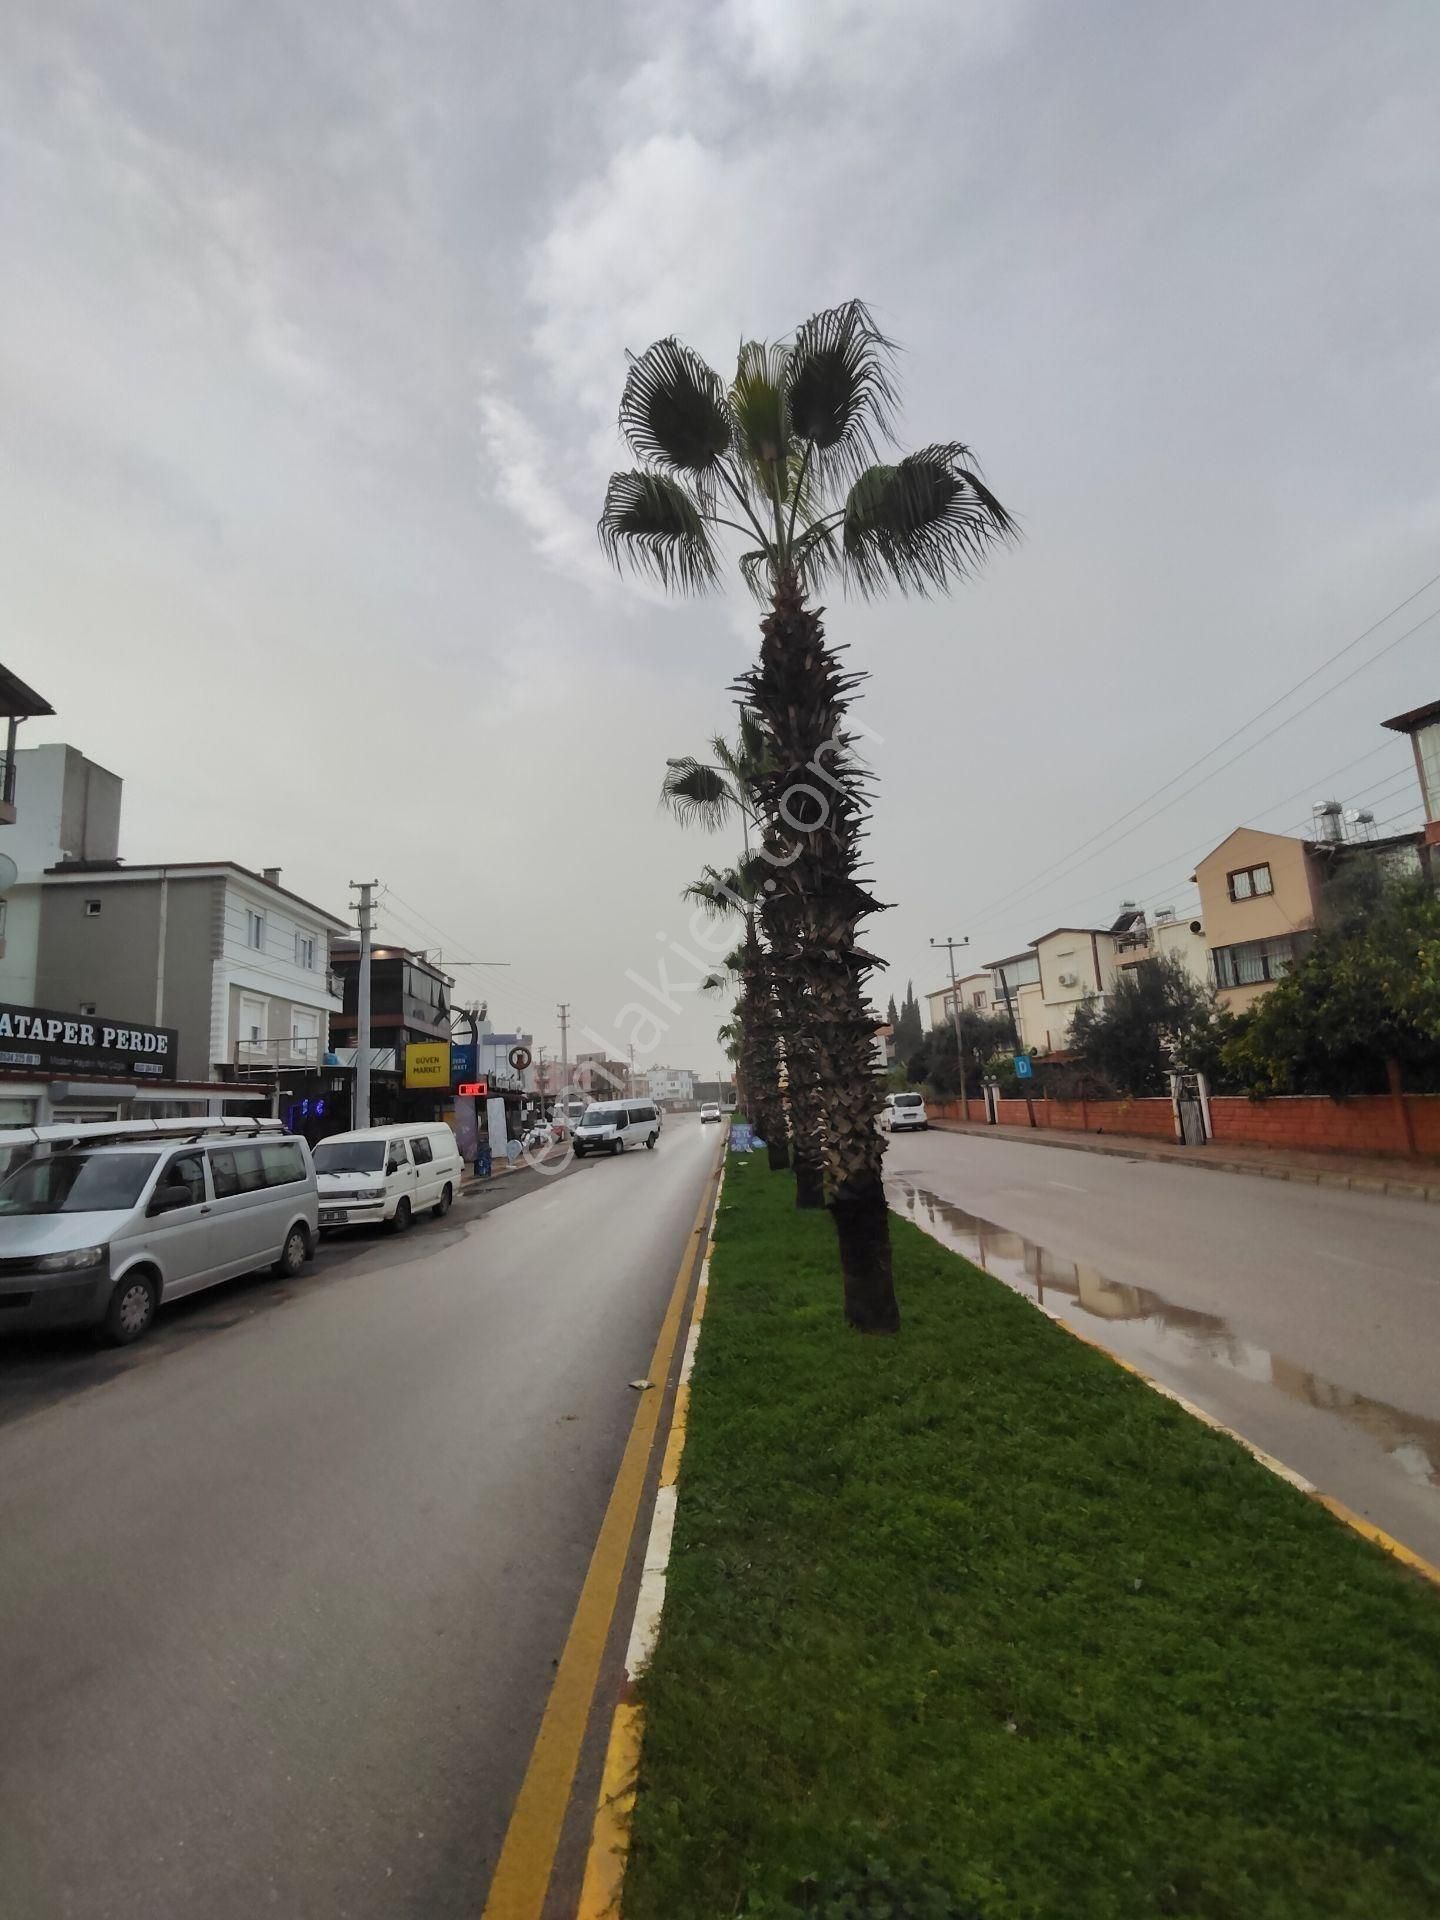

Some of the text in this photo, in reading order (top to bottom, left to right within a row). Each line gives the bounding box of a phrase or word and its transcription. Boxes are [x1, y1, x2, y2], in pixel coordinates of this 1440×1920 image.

[102, 1027, 168, 1054] PERDE
[415, 1055, 440, 1065] GÜVEN
[413, 1066, 442, 1074] MARKET
[1018, 1061, 1027, 1074] D
